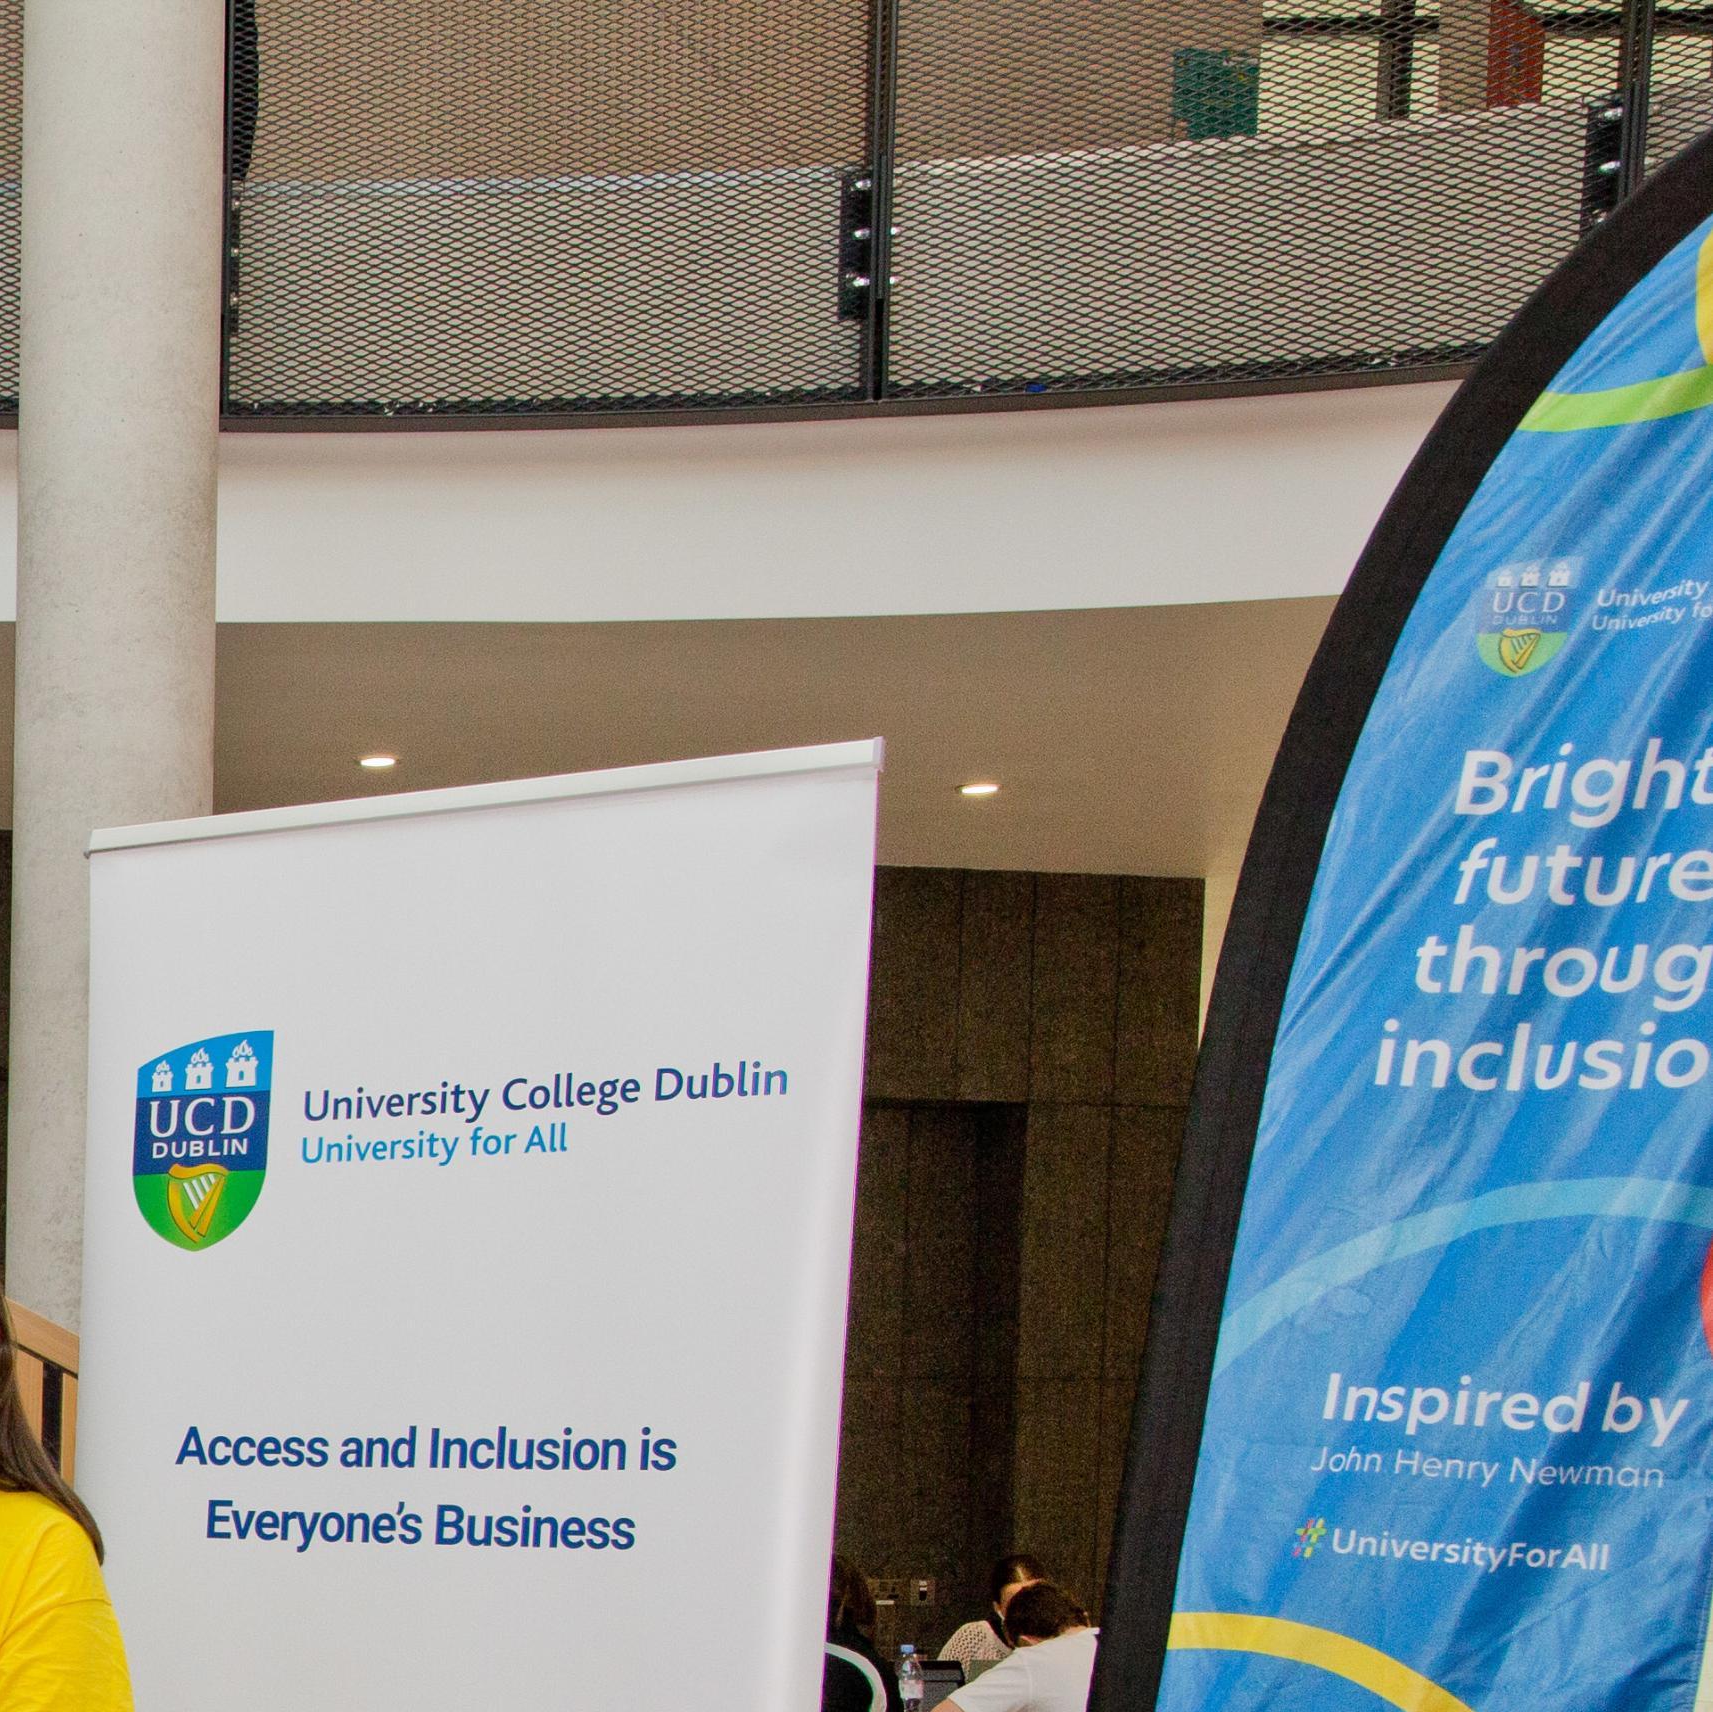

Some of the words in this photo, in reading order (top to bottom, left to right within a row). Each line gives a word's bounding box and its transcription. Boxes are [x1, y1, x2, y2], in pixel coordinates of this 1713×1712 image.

[1493, 591, 1566, 613] UCD
[1597, 580, 1711, 607] University
[1593, 606, 1686, 631] University
[303, 1081, 490, 1124] University
[501, 1075, 642, 1115] College
[654, 1060, 788, 1104] Dublin
[148, 1096, 256, 1139] UCD
[151, 1138, 250, 1159] DUBLIN
[301, 1129, 459, 1166] University
[470, 1126, 517, 1157] for
[524, 1123, 569, 1154] All
[1323, 1373, 1592, 1435] Inspired
[1602, 1382, 1689, 1447] by
[175, 1426, 329, 1467] Access
[340, 1426, 417, 1469] and
[429, 1427, 627, 1471] Inclusion
[638, 1427, 677, 1472] is
[1311, 1446, 1382, 1474] John
[1394, 1450, 1500, 1487] Henry
[1510, 1457, 1665, 1488] Newman
[206, 1500, 422, 1552] Everyone's
[435, 1504, 636, 1551] Business
